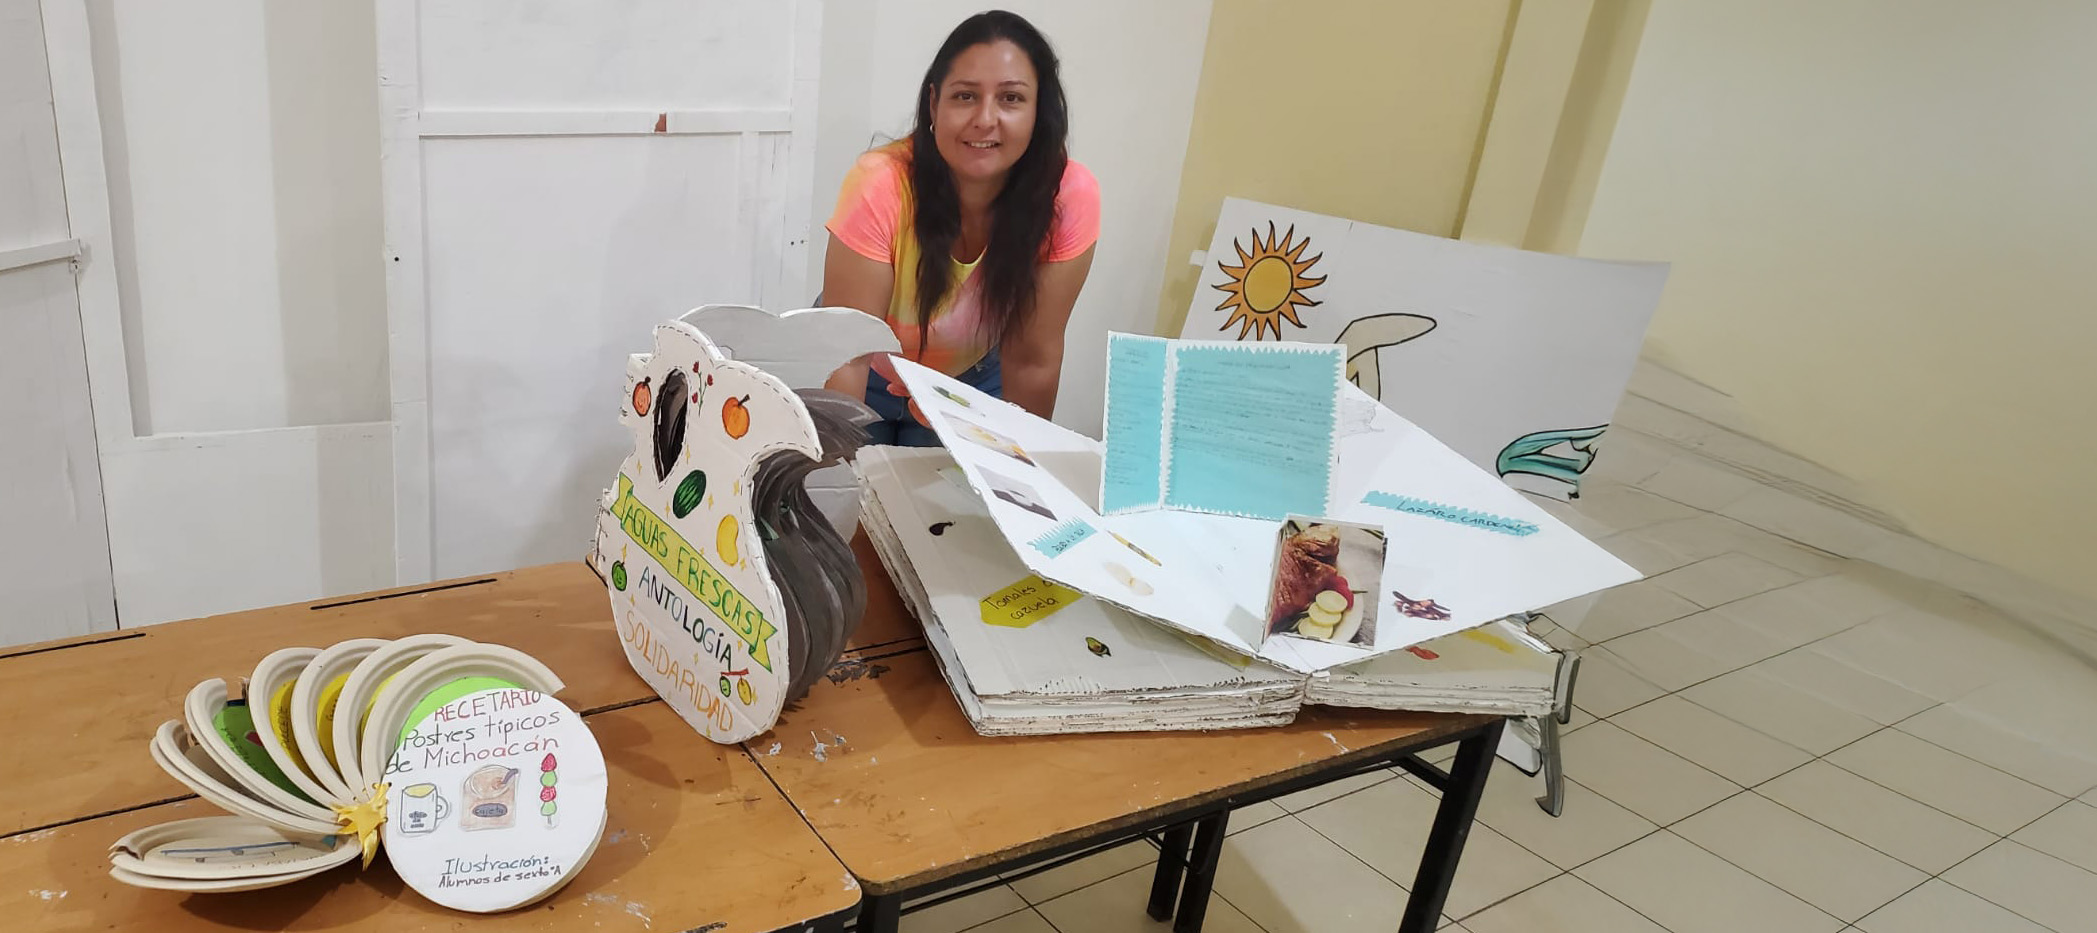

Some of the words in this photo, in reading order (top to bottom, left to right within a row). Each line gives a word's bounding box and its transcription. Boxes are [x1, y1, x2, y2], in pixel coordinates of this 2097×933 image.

[623, 503, 668, 558] AGUAS
[676, 545, 755, 635] FRESCAS
[638, 565, 732, 673] ANTOLOGÍA
[1010, 596, 1060, 620] cazuela
[623, 609, 734, 732] SOLIDARIDAD
[434, 689, 542, 722] RECETARIO
[403, 723, 476, 752] Postres
[484, 711, 560, 745] típicos
[385, 752, 414, 775] de
[424, 735, 559, 769] Michoacán
[438, 875, 490, 889] Alumnos
[494, 871, 511, 883] de
[515, 866, 549, 880] sexto
